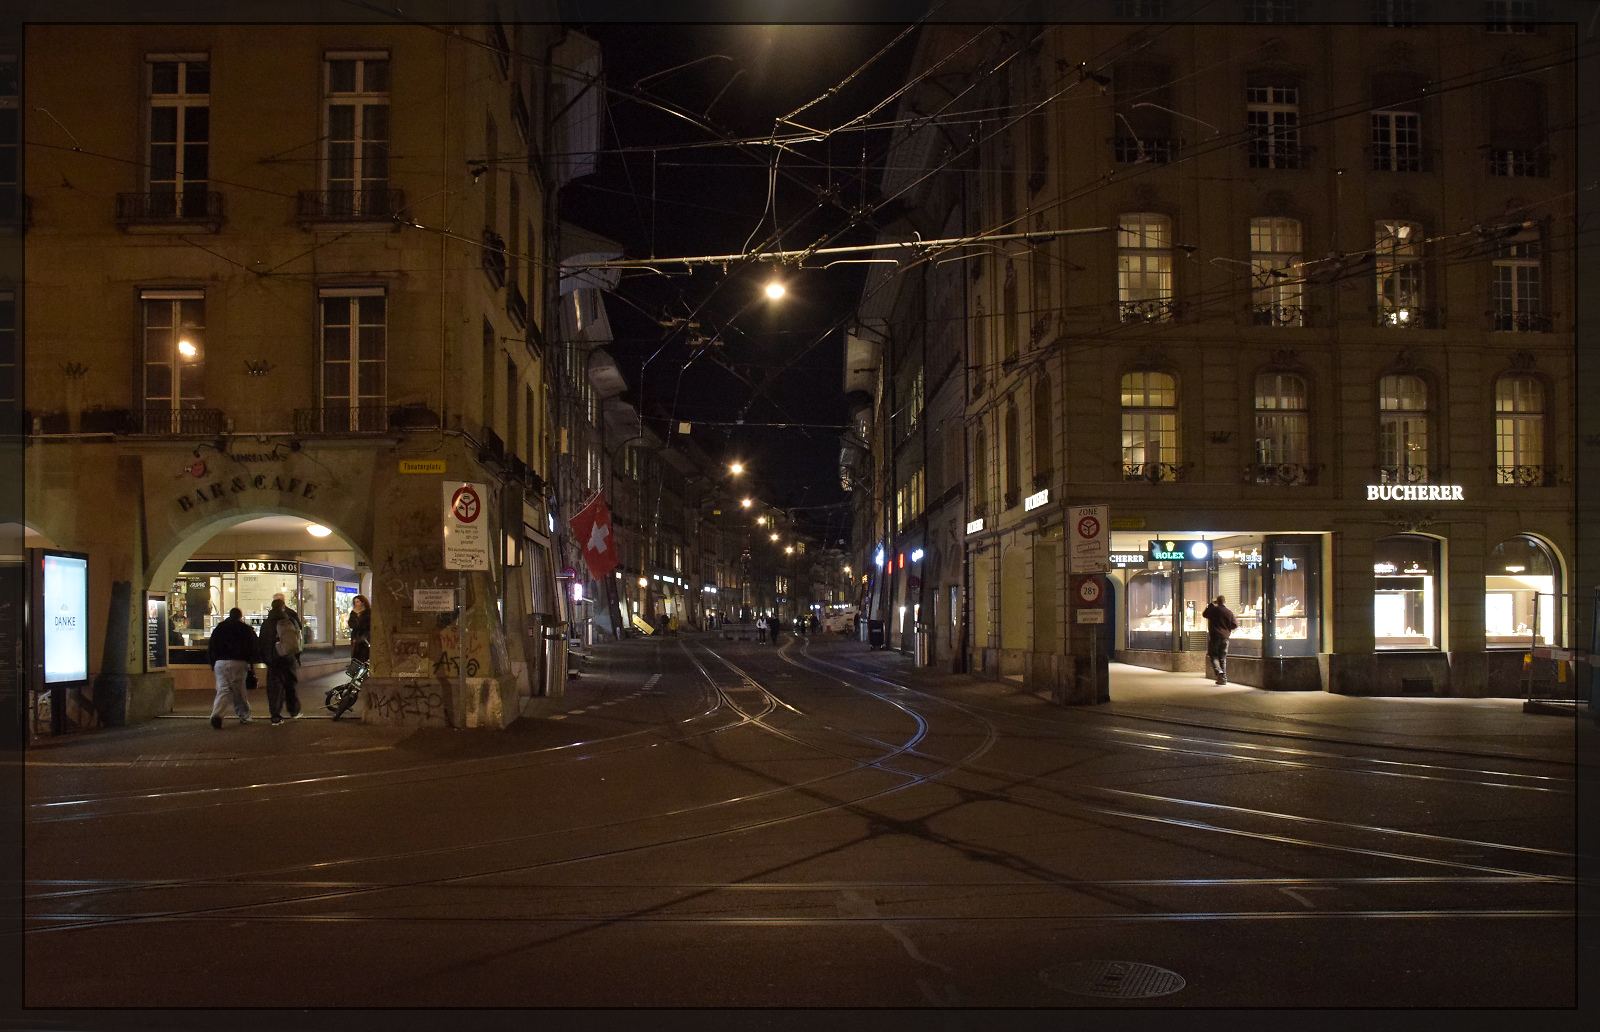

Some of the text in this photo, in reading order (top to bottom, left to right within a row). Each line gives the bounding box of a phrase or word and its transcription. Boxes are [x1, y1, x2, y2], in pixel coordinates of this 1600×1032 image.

[178, 482, 225, 512] BAR
[231, 476, 246, 493] &
[1366, 485, 1464, 500] BUCHERER
[1078, 508, 1098, 516] ZONE
[1109, 554, 1144, 563] CHERER
[1155, 552, 1185, 560] ROLEX
[240, 562, 298, 572] ADRIANOS
[54, 616, 76, 627] DANKE
